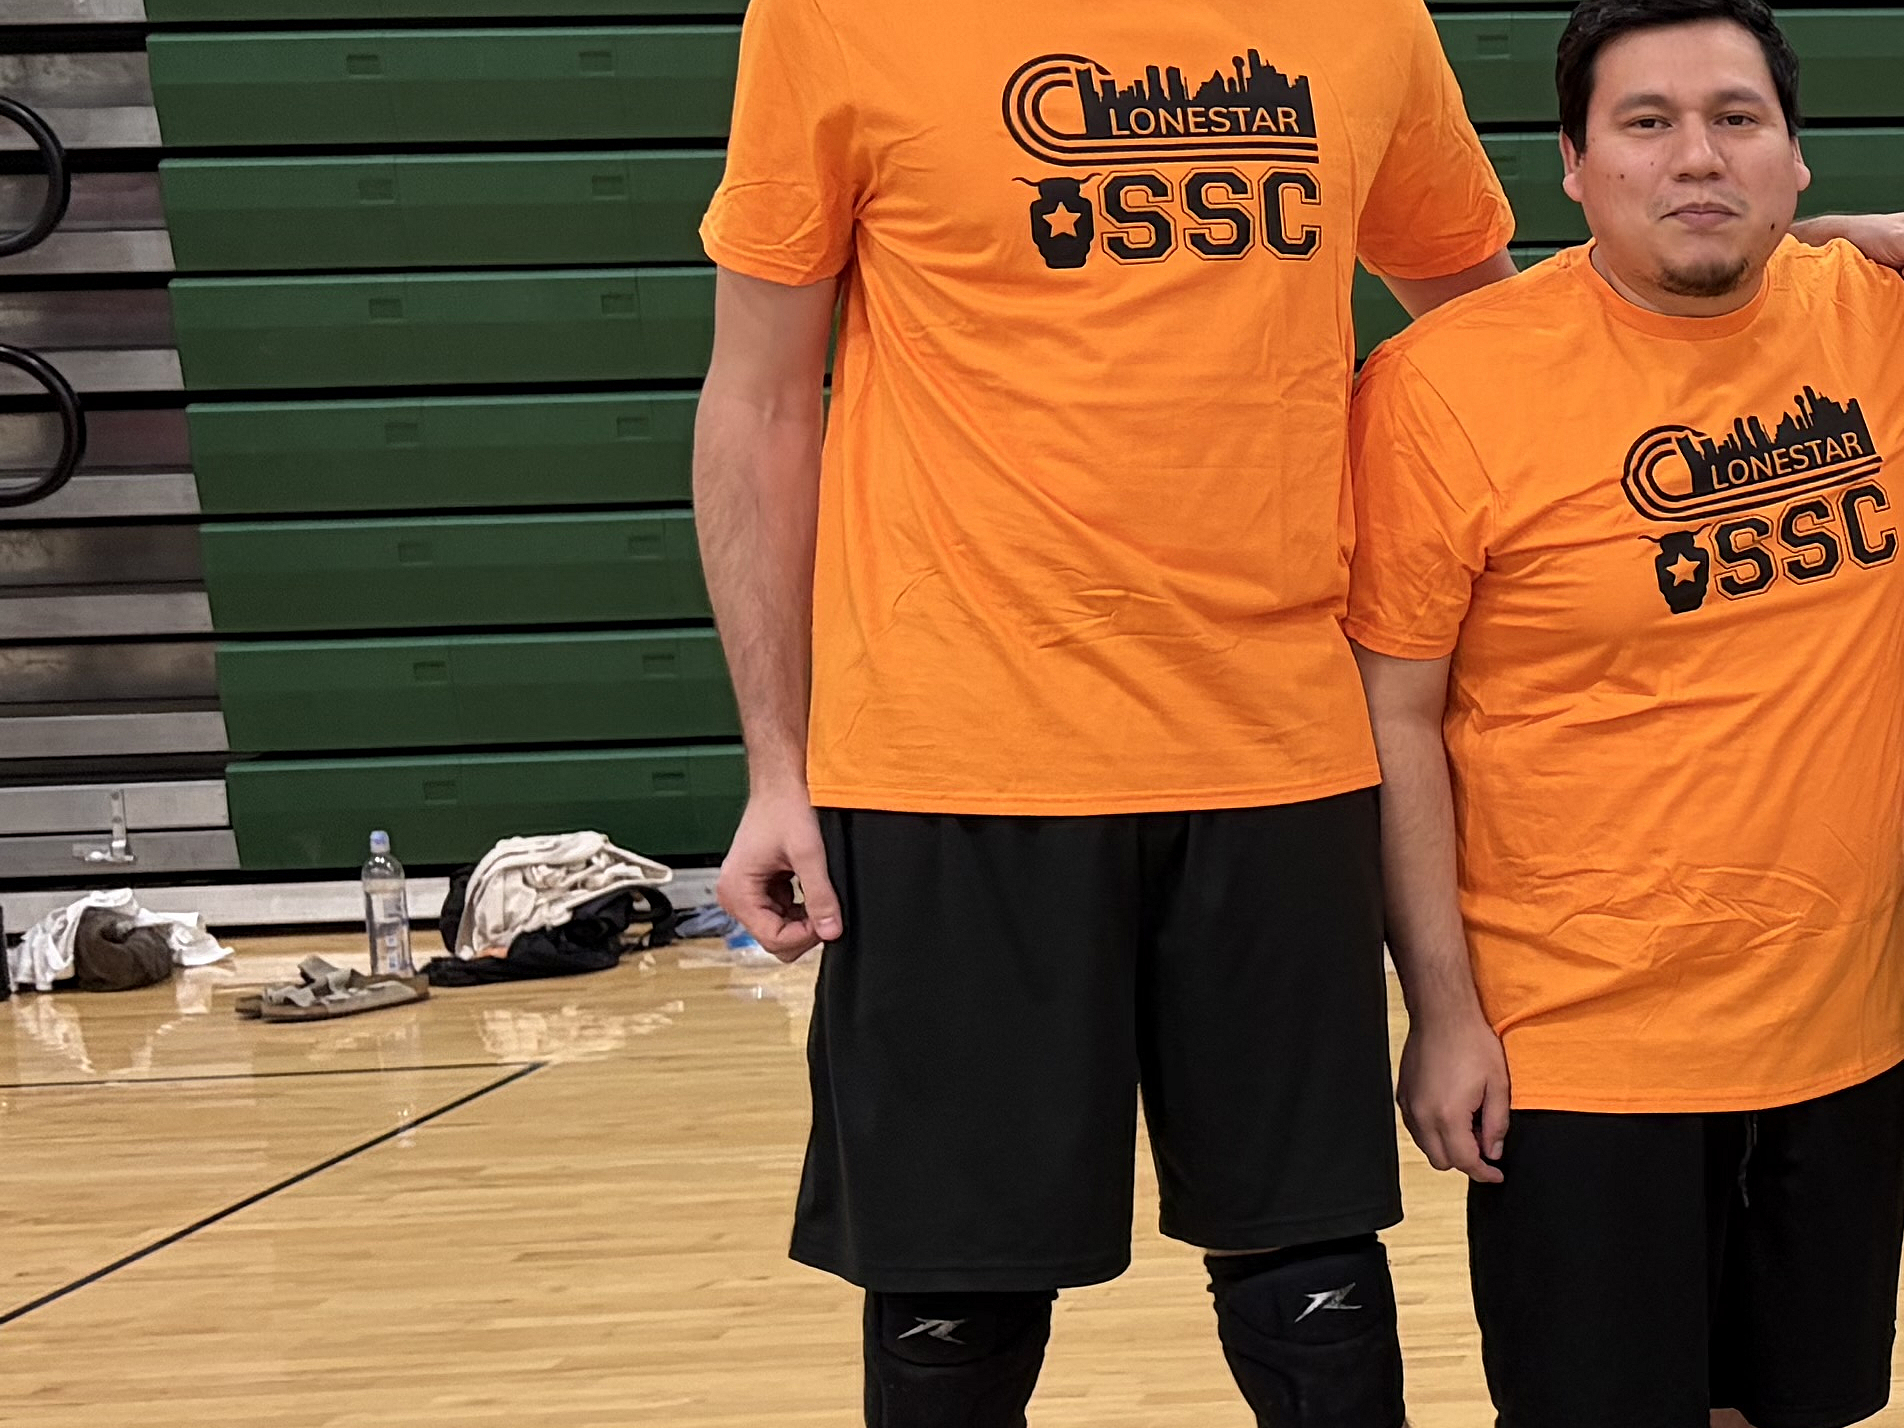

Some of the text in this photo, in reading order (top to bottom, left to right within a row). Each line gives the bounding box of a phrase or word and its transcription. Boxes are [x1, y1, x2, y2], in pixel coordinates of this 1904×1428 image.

[1109, 104, 1300, 136] LONESTAR
[1099, 168, 1322, 264] SSC
[1711, 430, 1862, 490] LONESTAR
[1710, 484, 1897, 600] SSC
